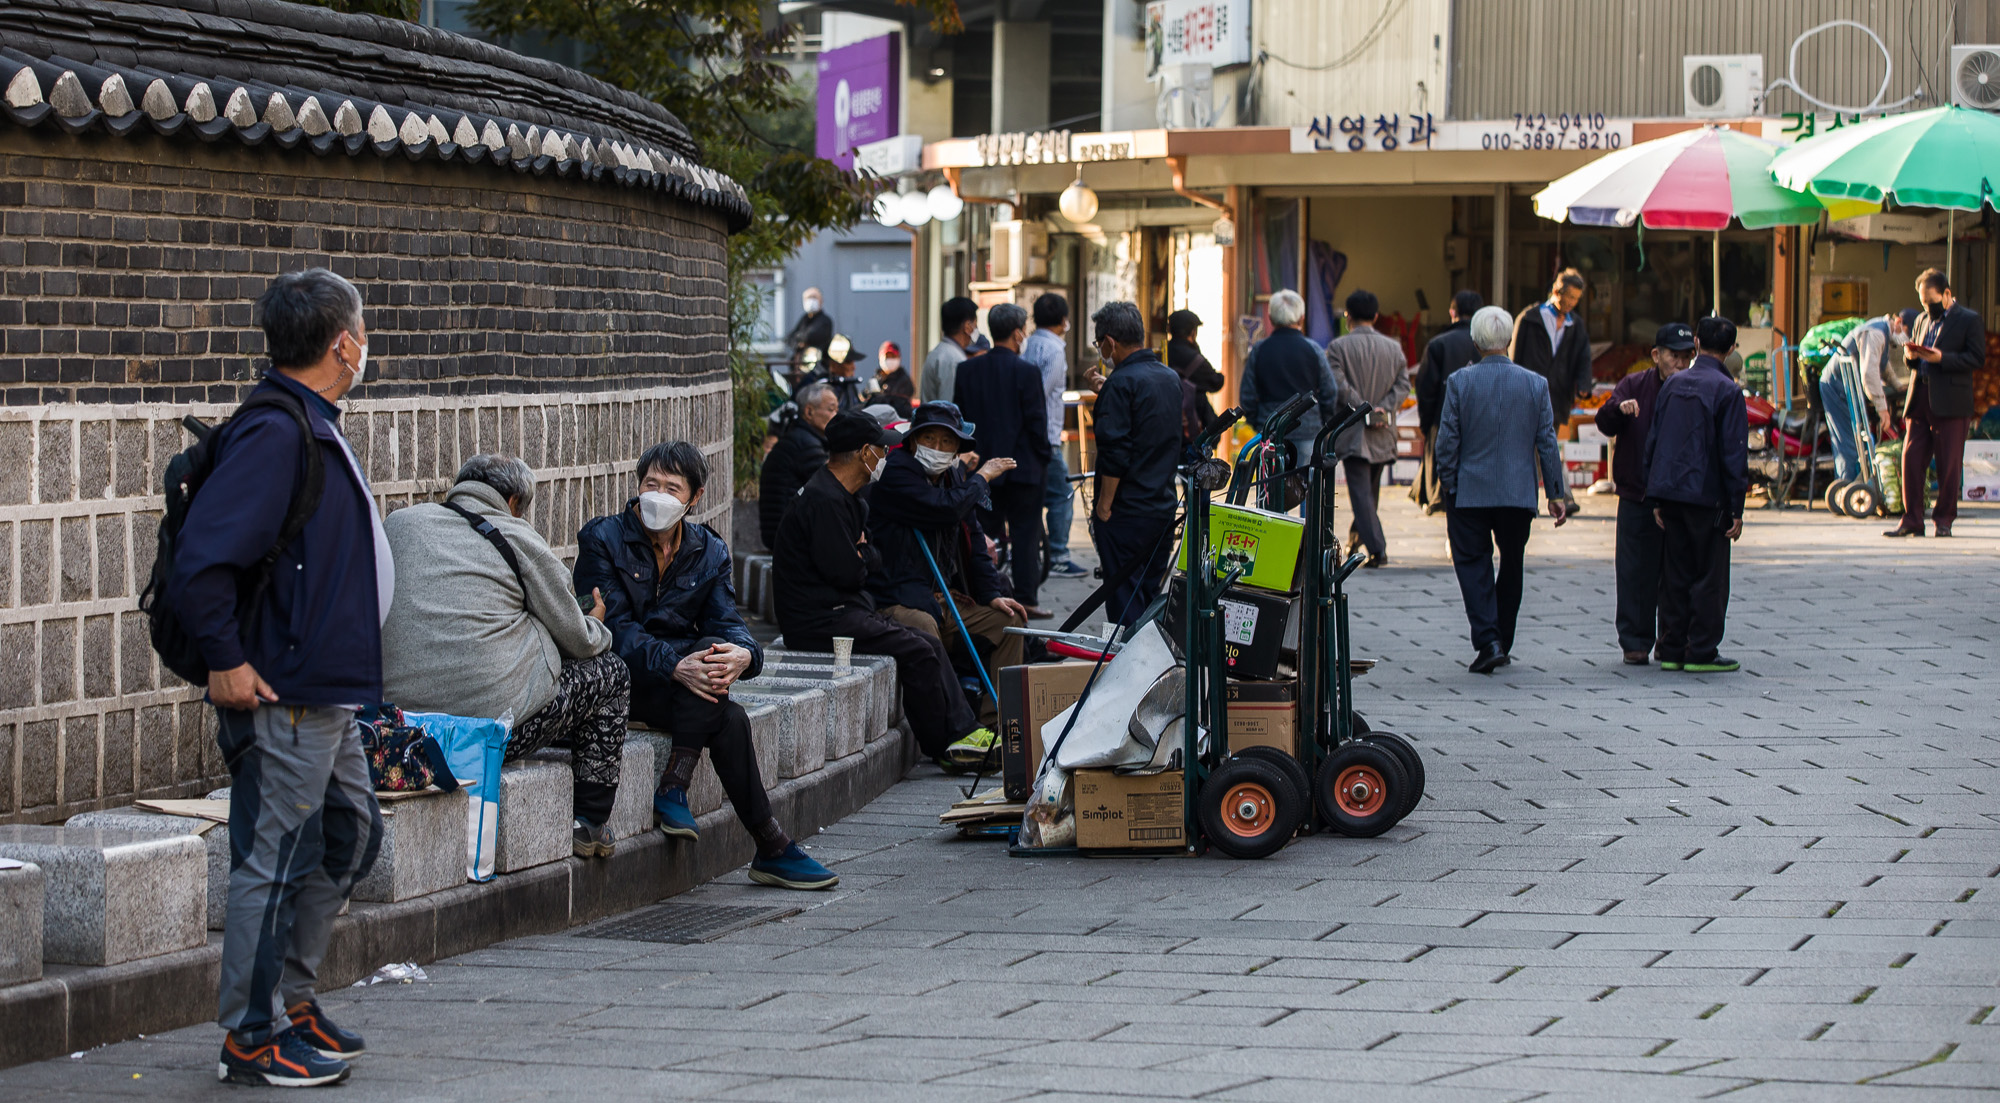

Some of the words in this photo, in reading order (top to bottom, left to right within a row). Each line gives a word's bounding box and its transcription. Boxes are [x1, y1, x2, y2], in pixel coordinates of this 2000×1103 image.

[1514, 112, 1605, 131] 742-0410
[1306, 112, 1437, 151] 신영청과
[1482, 132, 1620, 150] 010-3897-8210
[1226, 533, 1256, 549] 사과
[1010, 718, 1020, 754] KELIM
[1082, 810, 1124, 822] Simplot
